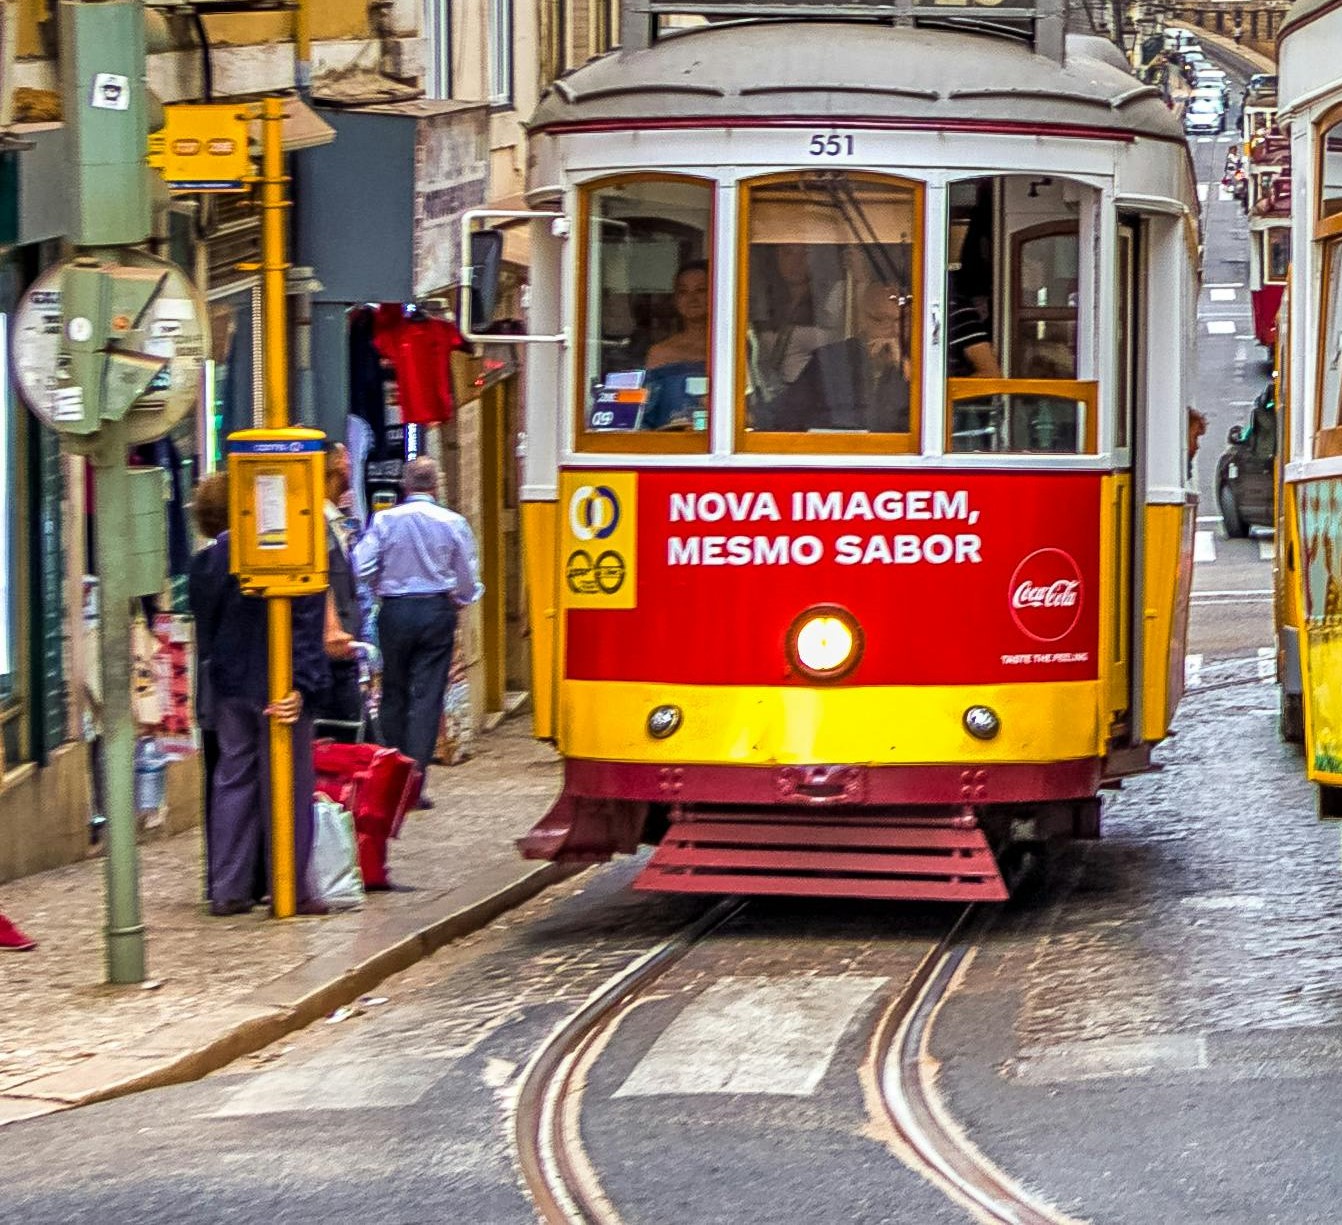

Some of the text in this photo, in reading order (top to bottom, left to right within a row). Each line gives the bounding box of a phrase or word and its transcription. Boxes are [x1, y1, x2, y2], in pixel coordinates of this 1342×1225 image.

[809, 134, 854, 156] 551
[669, 490, 981, 526] NOVA IMAGEM,
[667, 533, 983, 566] MESMO SABOR
[1012, 579, 1080, 610] Coca-Cola
